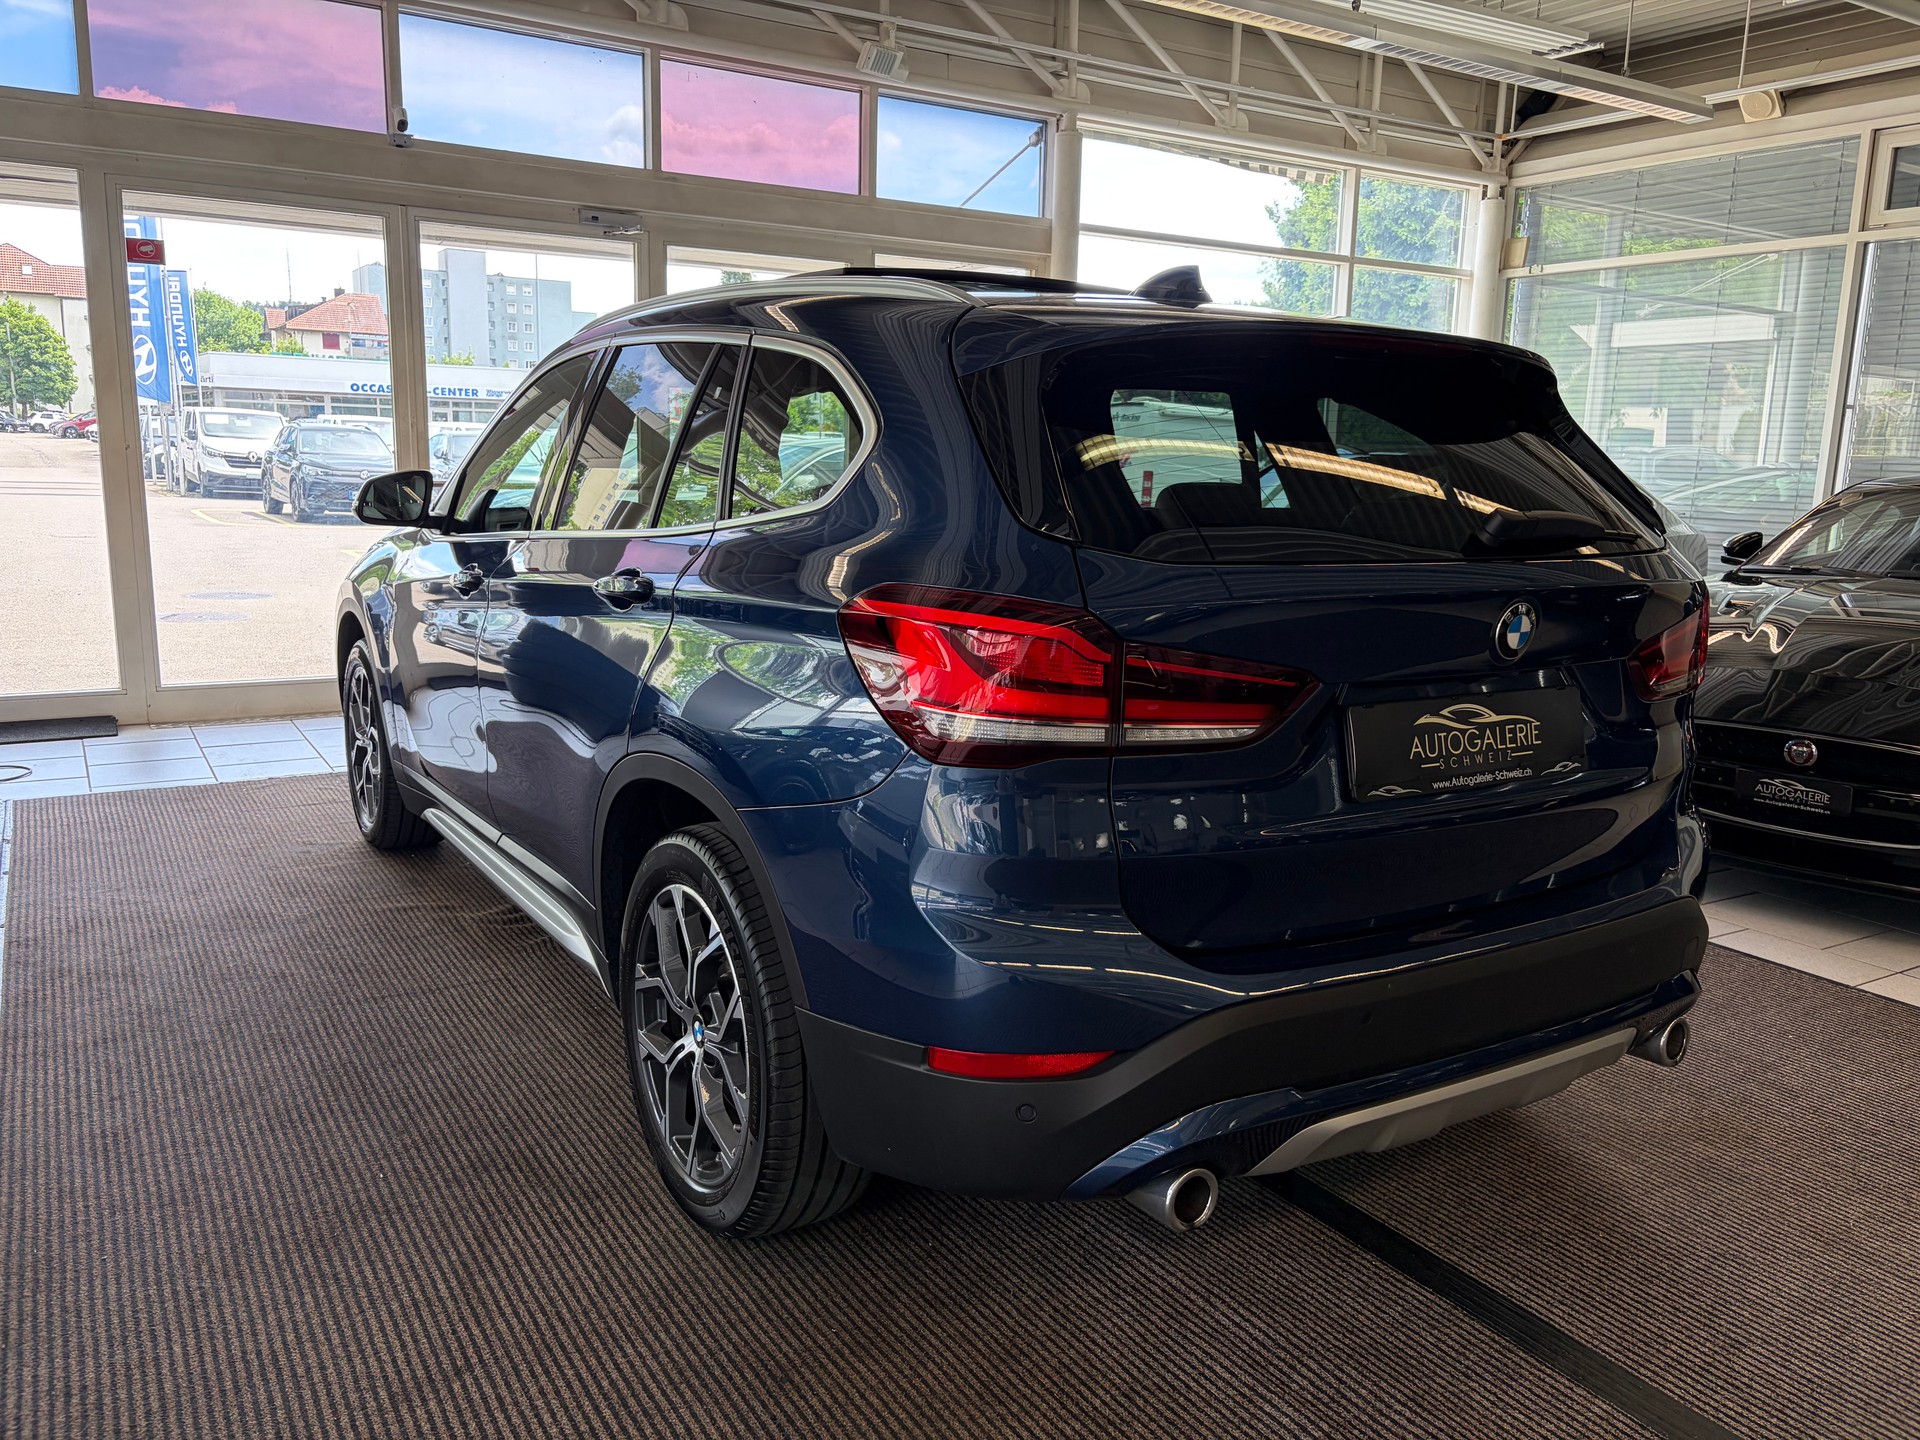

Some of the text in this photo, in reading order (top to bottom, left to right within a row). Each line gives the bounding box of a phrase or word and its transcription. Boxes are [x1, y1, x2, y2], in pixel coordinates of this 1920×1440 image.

[1410, 722, 1542, 760] AUTOGALERIE
[1439, 750, 1512, 770] SCHWEIZ
[1432, 767, 1533, 789] www.Autogalerie-Schweiz.ch
[1755, 783, 1831, 804] AUTOGALERIE
